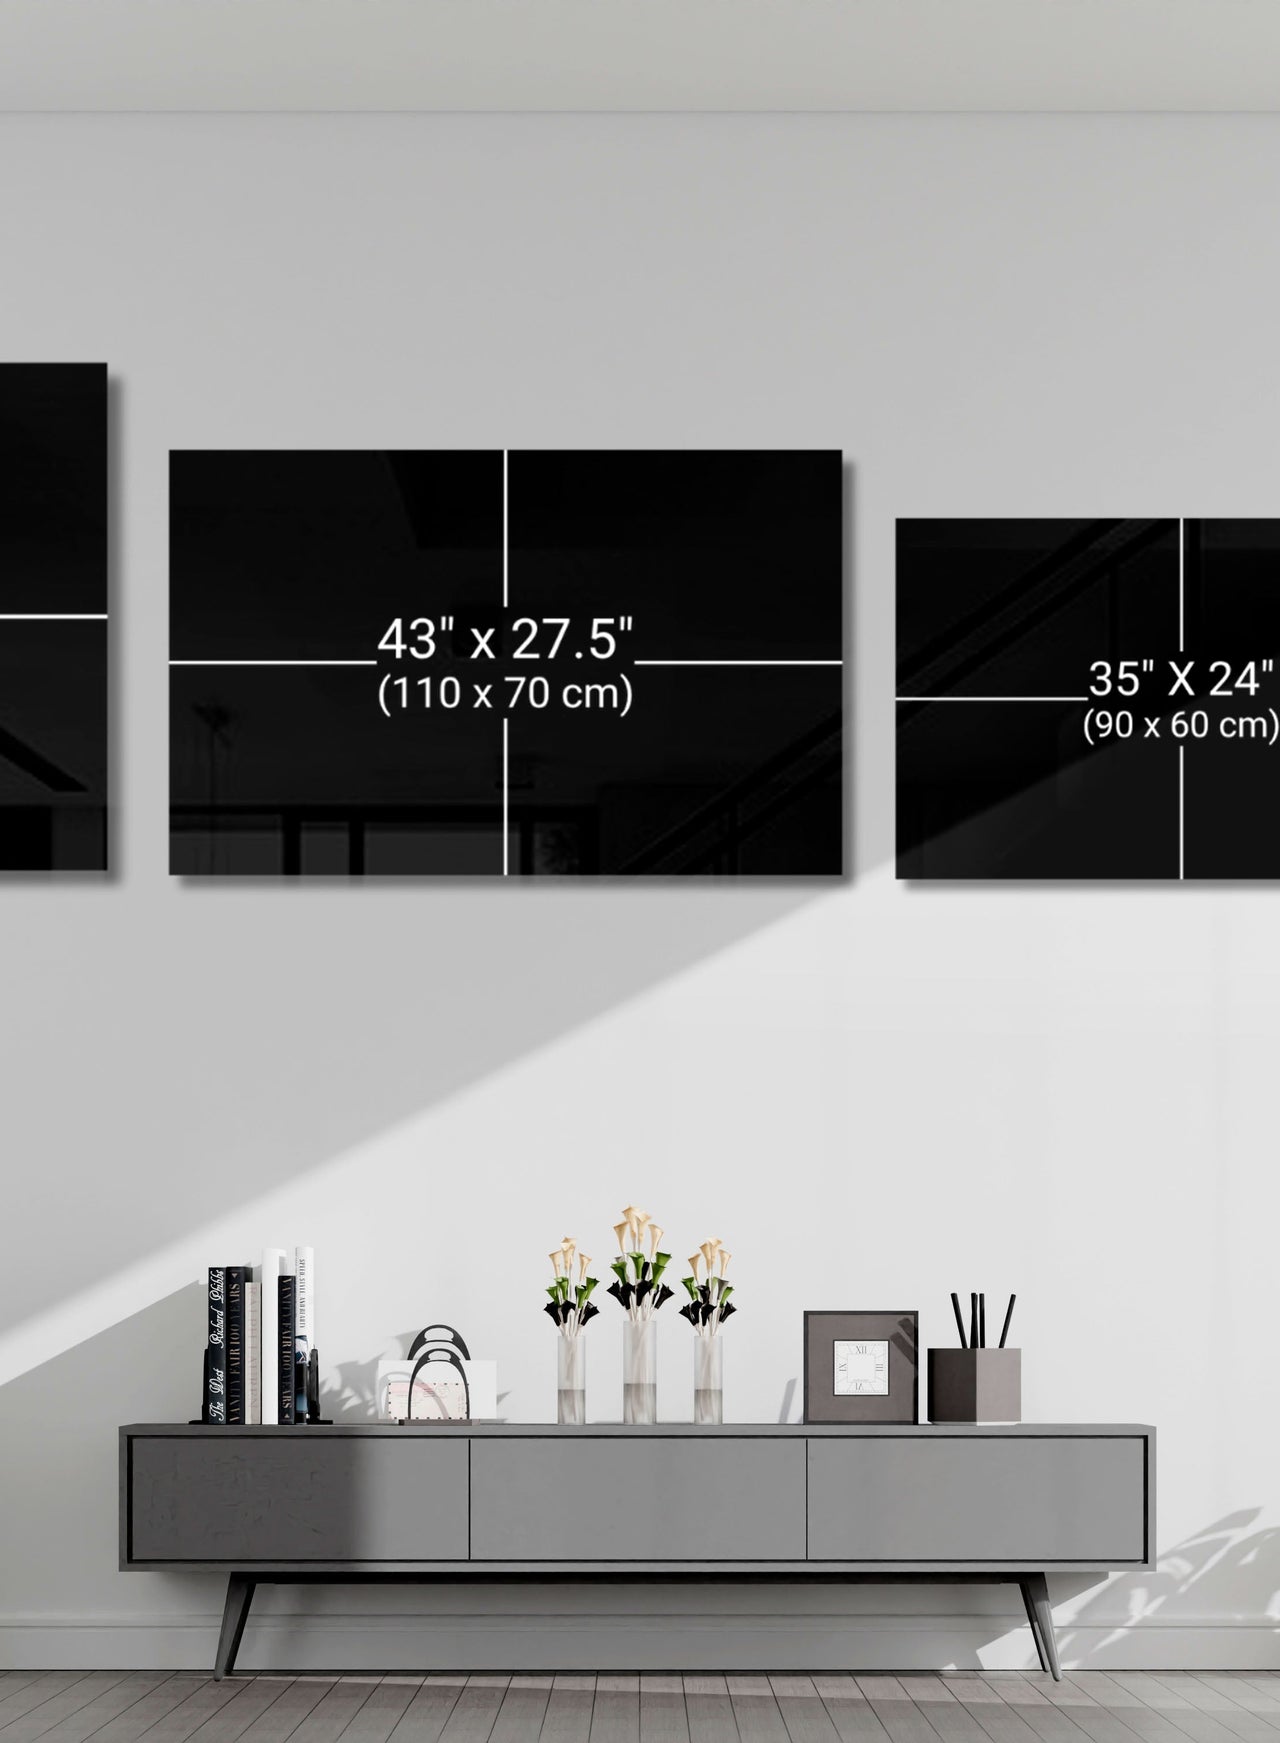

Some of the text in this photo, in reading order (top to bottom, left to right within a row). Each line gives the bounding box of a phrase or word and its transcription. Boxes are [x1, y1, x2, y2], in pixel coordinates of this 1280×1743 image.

[209, 1269, 225, 1349] Richard Phibbs
[229, 1283, 240, 1320] YEARS
[282, 1322, 292, 1348] FAIR
[229, 1348, 240, 1375] FAIR
[209, 1367, 225, 1421] The West
[229, 1380, 240, 1422] VANITY
